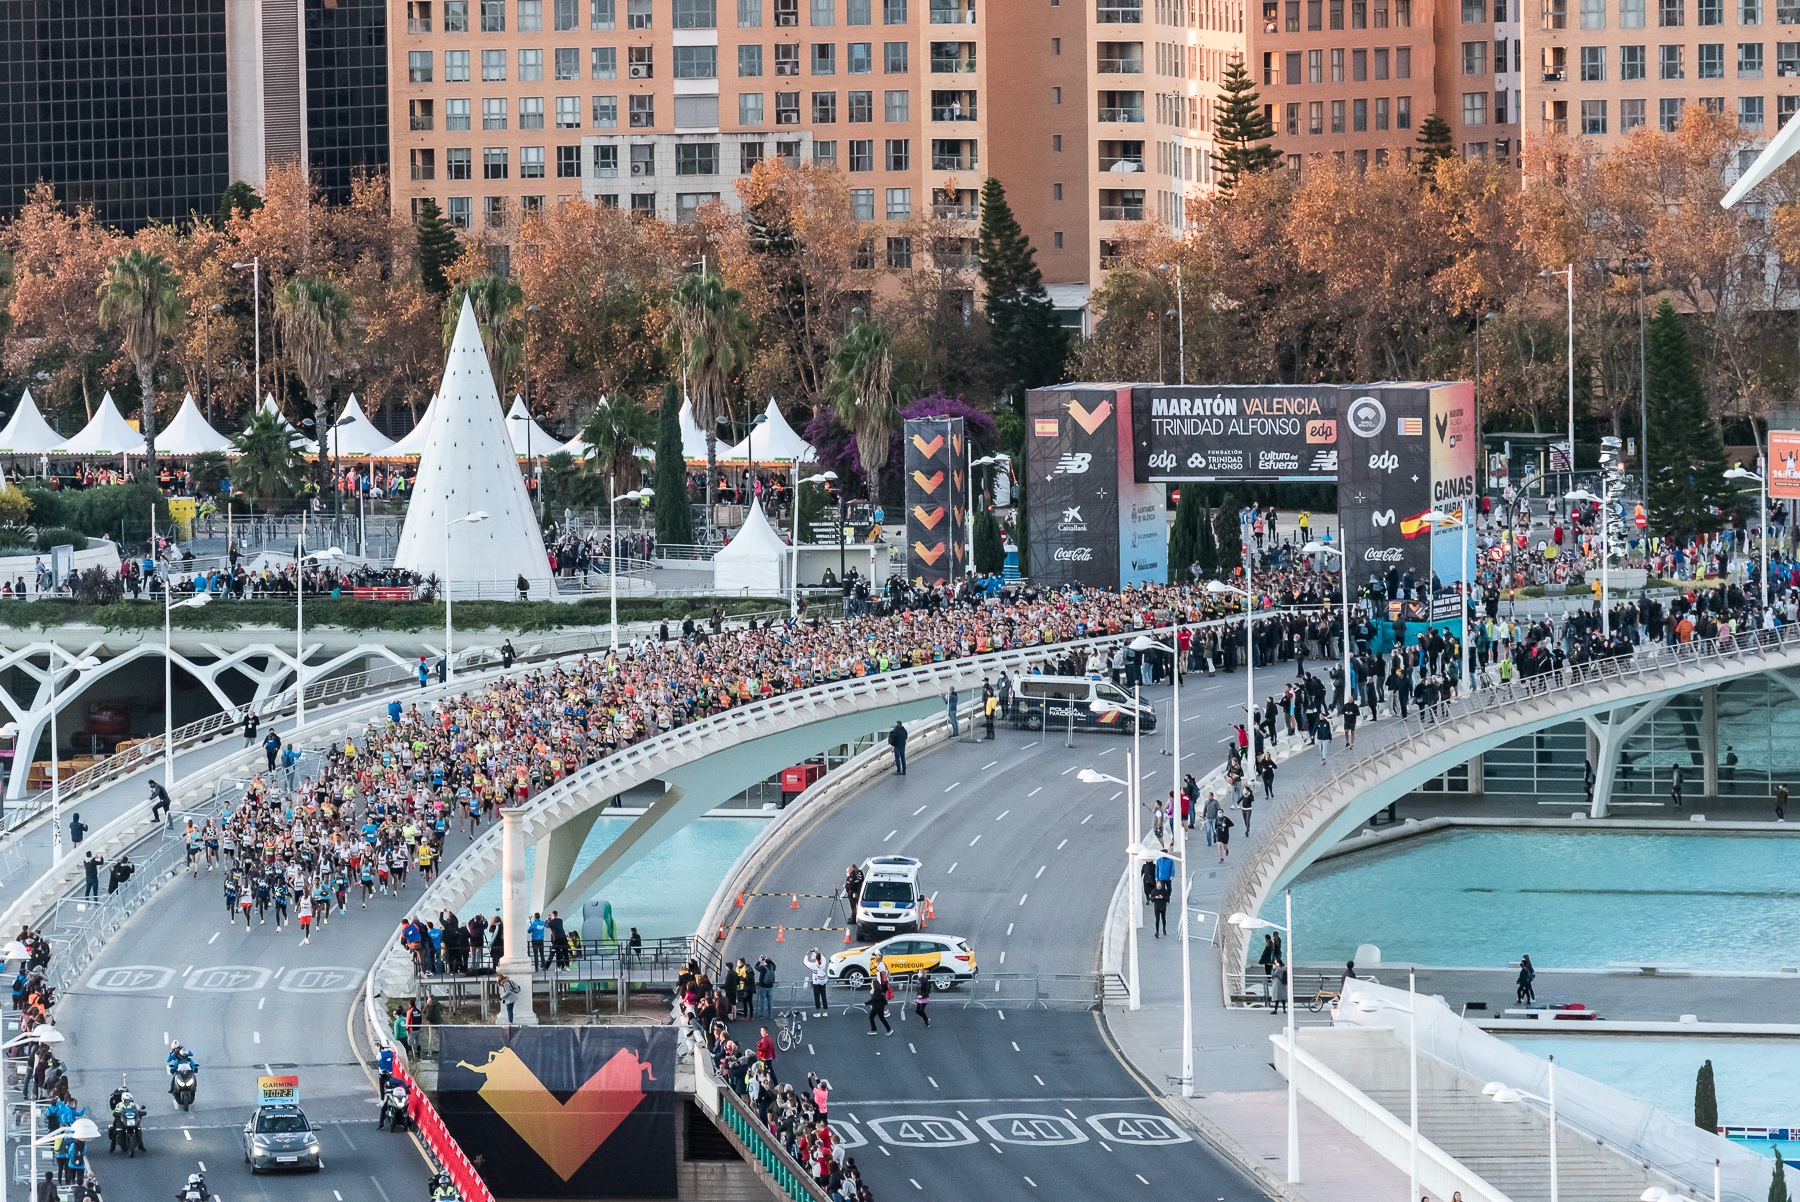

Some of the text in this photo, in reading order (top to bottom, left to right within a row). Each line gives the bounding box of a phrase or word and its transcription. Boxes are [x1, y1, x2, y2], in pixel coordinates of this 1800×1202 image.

[1152, 394, 1322, 416] MARATÓN VALENCIA
[1152, 418, 1300, 436] TRINIDAD ALFONSO
[1309, 422, 1333, 440] edp
[1148, 450, 1178, 472] edp
[1259, 450, 1290, 460] Cultura
[1368, 450, 1400, 474] edp
[1258, 460, 1298, 470] Esfuerzo
[1434, 475, 1474, 502] GANAS
[899, 1122, 957, 1142] 40
[1010, 1120, 1069, 1139] 40
[1117, 1119, 1176, 1138] 40
